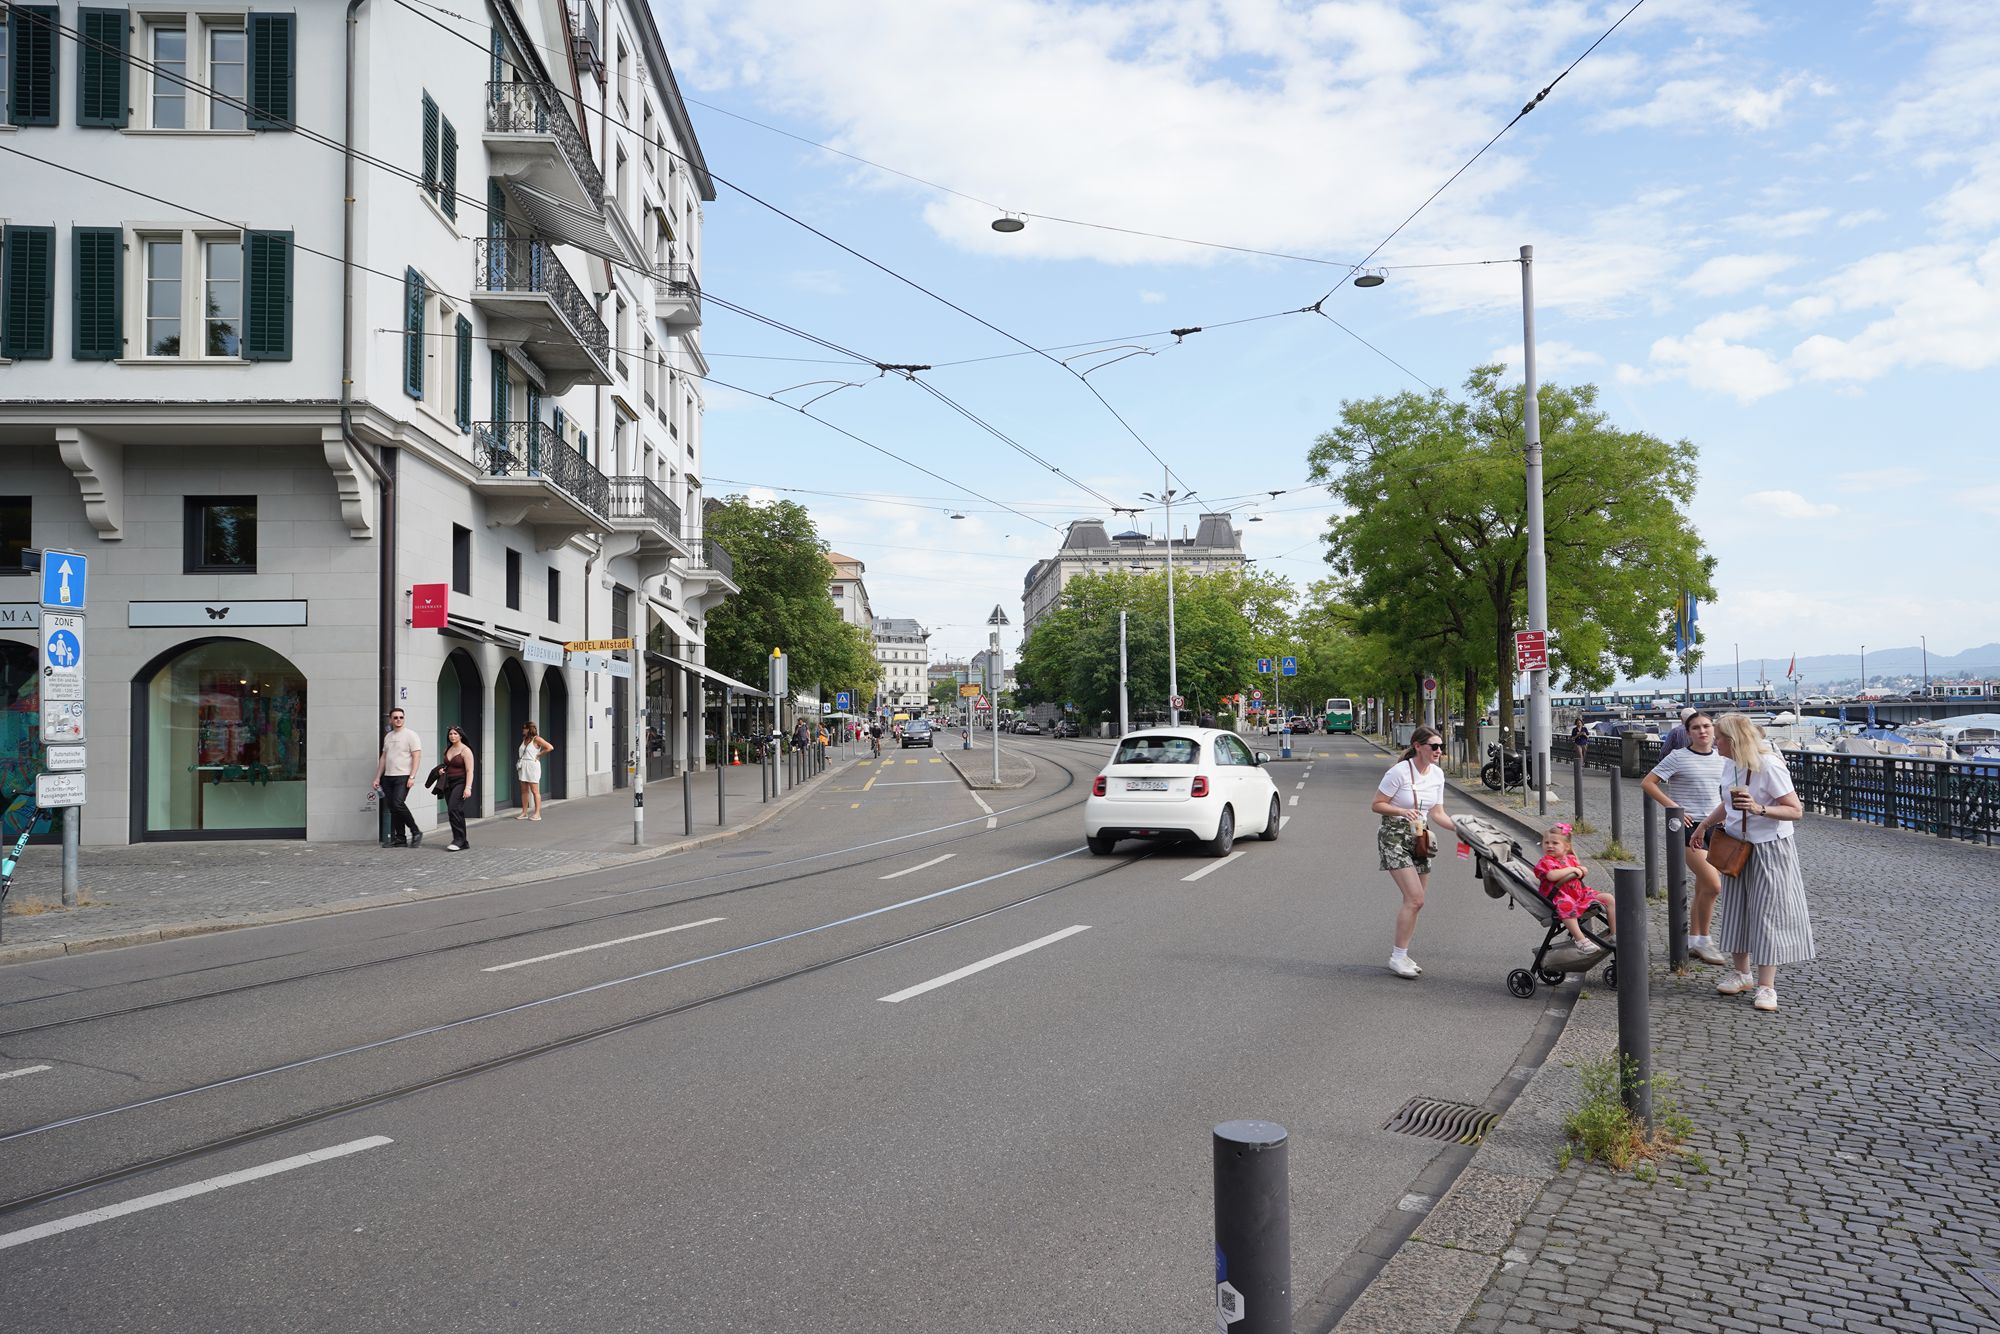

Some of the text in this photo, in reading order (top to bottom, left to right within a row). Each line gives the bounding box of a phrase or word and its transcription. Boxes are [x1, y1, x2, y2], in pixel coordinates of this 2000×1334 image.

[54, 617, 74, 627] ZONE
[573, 640, 630, 651] HOTEL Altstadt
[527, 645, 561, 661] SEIDENMANN
